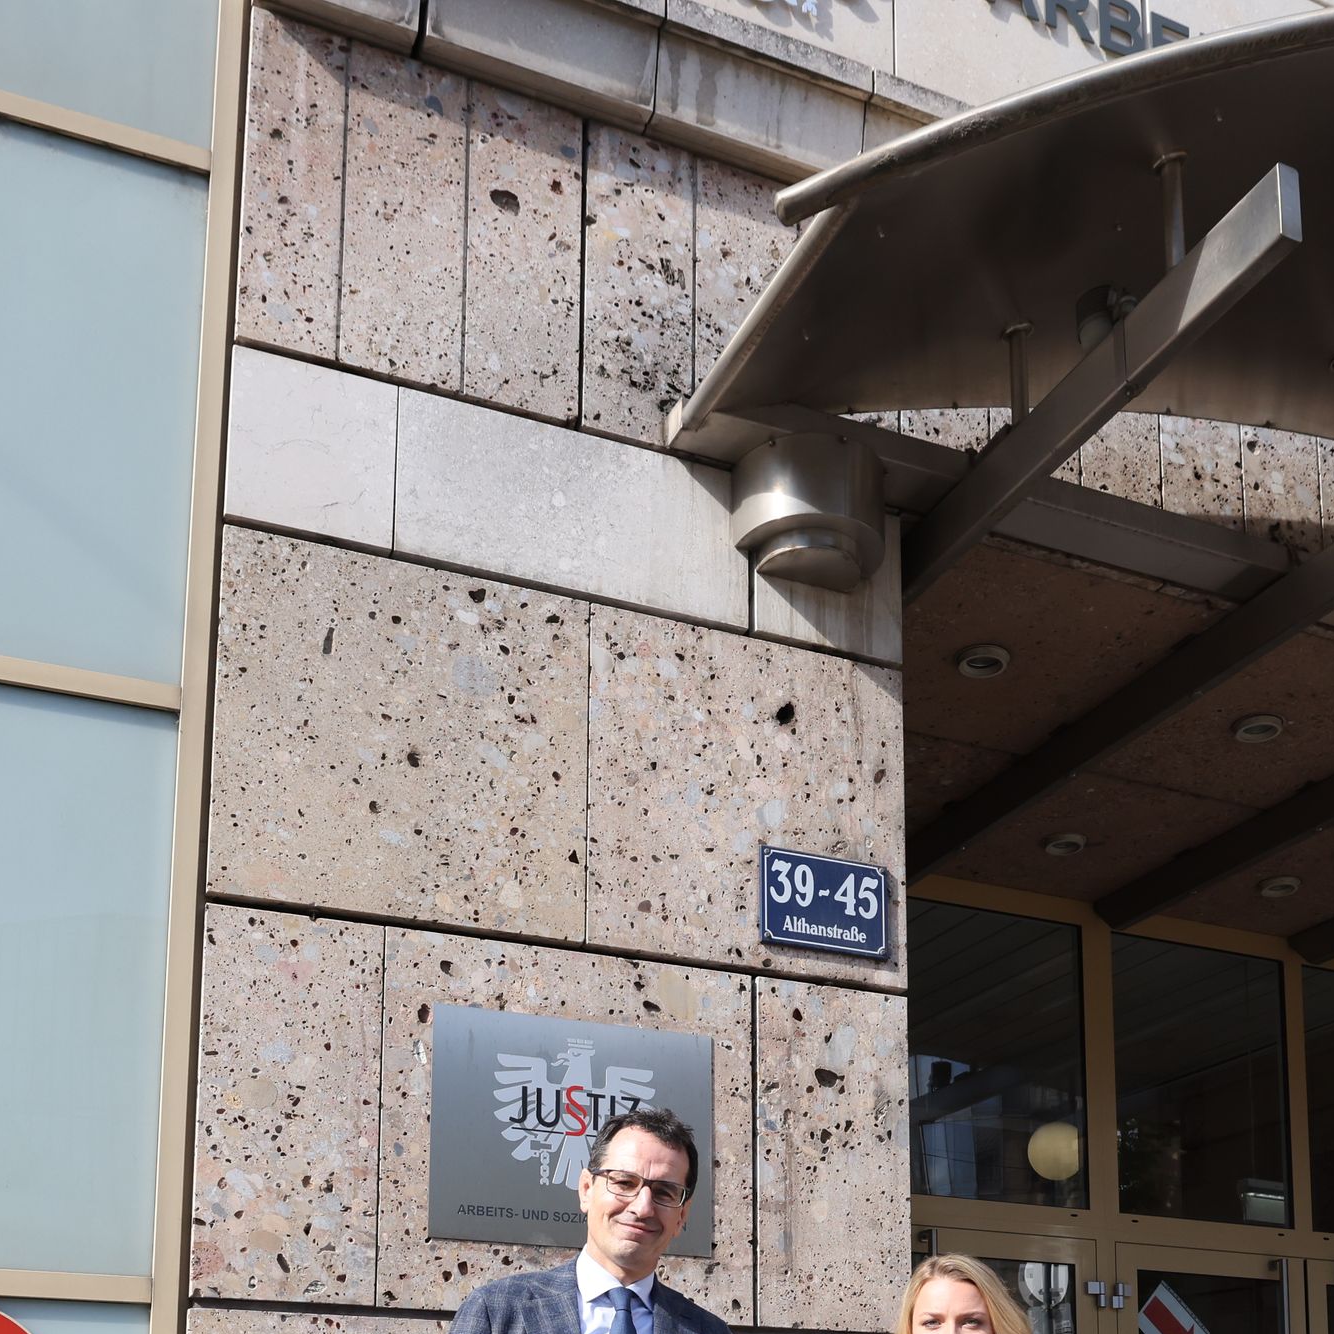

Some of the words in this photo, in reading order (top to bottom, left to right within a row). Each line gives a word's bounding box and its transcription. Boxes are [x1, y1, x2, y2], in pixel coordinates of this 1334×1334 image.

[769, 858, 879, 920] 39-45
[782, 915, 867, 943] Althanstraße
[457, 1203, 519, 1220] ARBEITS-
[522, 1209, 549, 1222] UND
